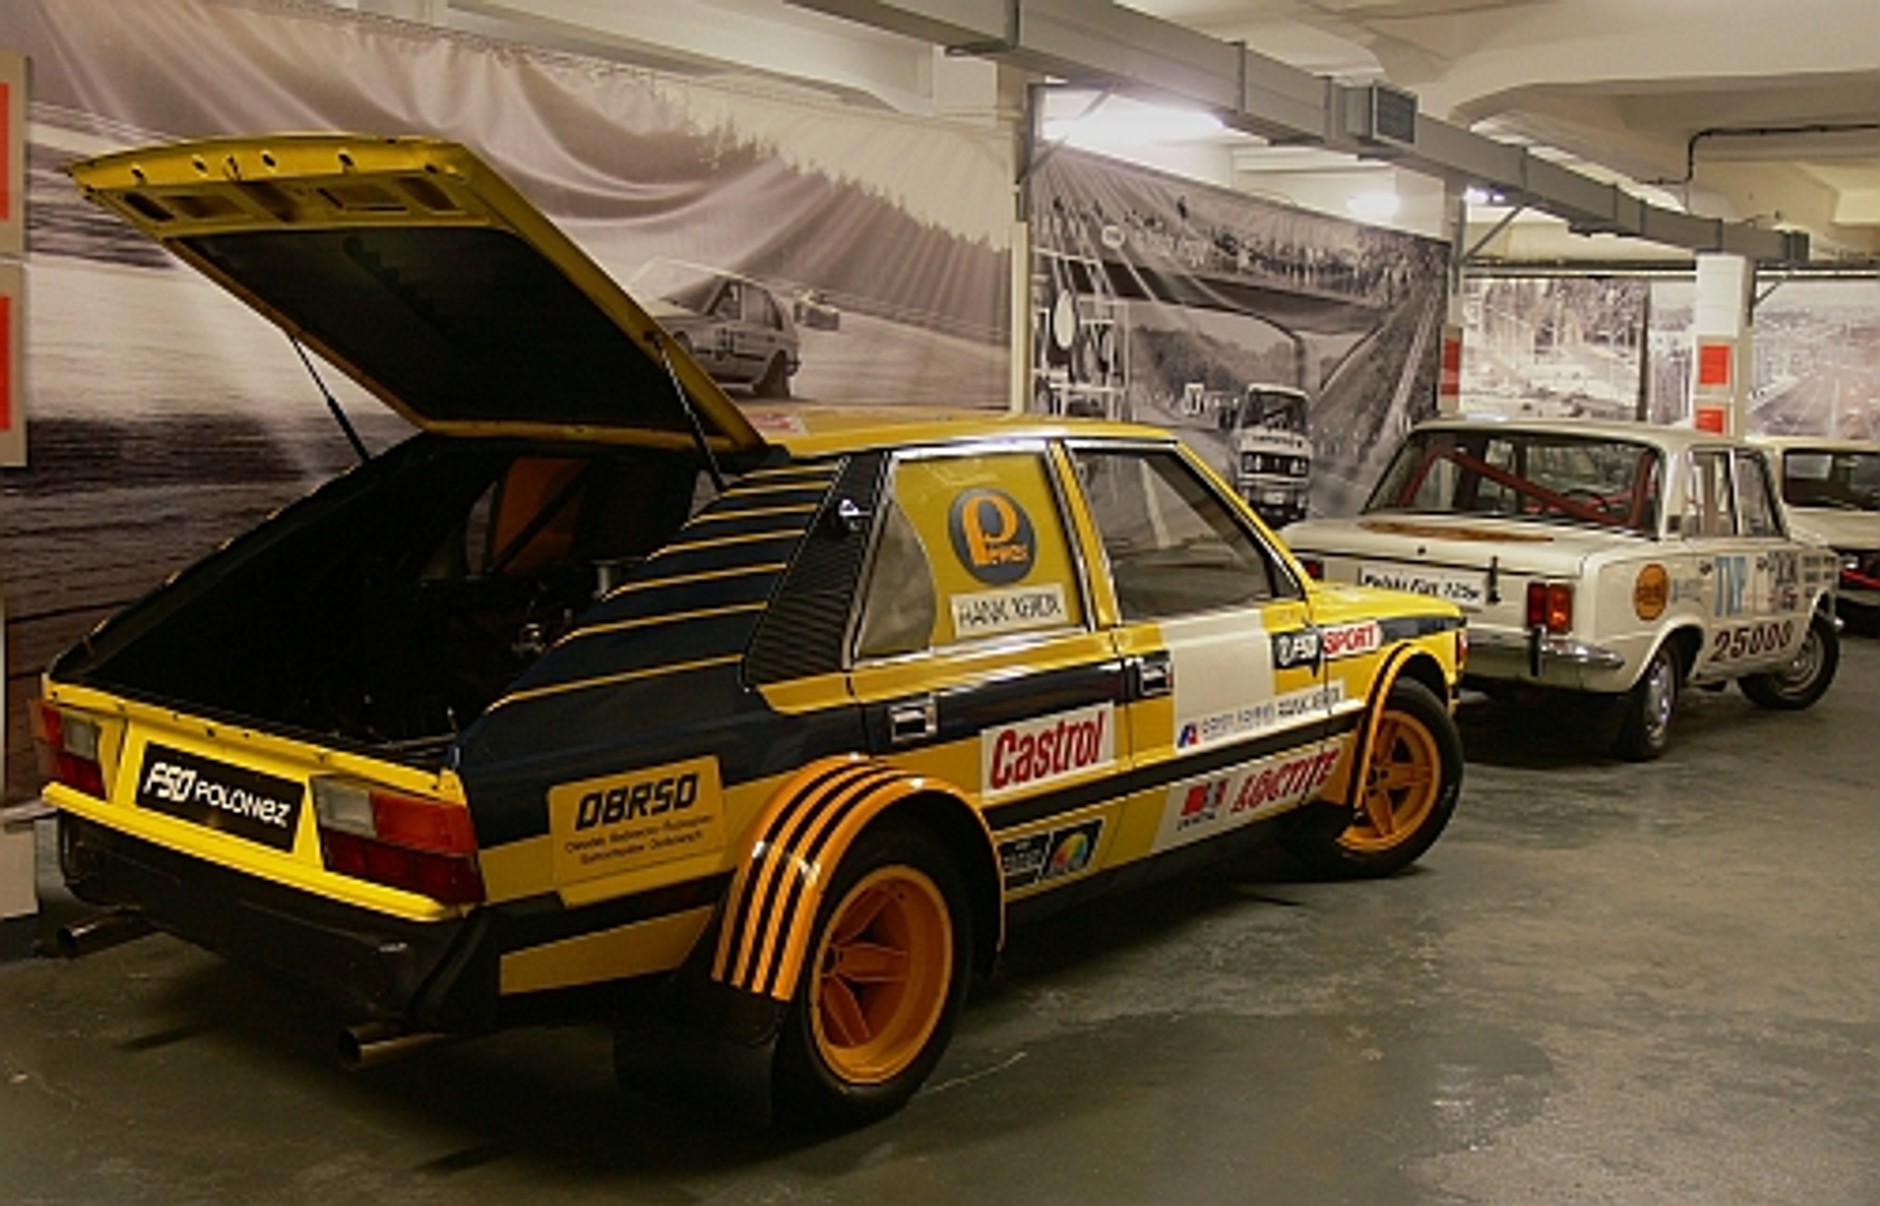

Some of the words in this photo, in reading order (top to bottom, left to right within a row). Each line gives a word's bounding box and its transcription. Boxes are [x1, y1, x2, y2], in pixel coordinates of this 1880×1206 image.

[1322, 623, 1375, 655] SPORT
[1708, 620, 1795, 662] 25000
[991, 709, 1106, 790] Castrol
[142, 761, 197, 802] FSO
[1231, 748, 1340, 813] LOCTITE
